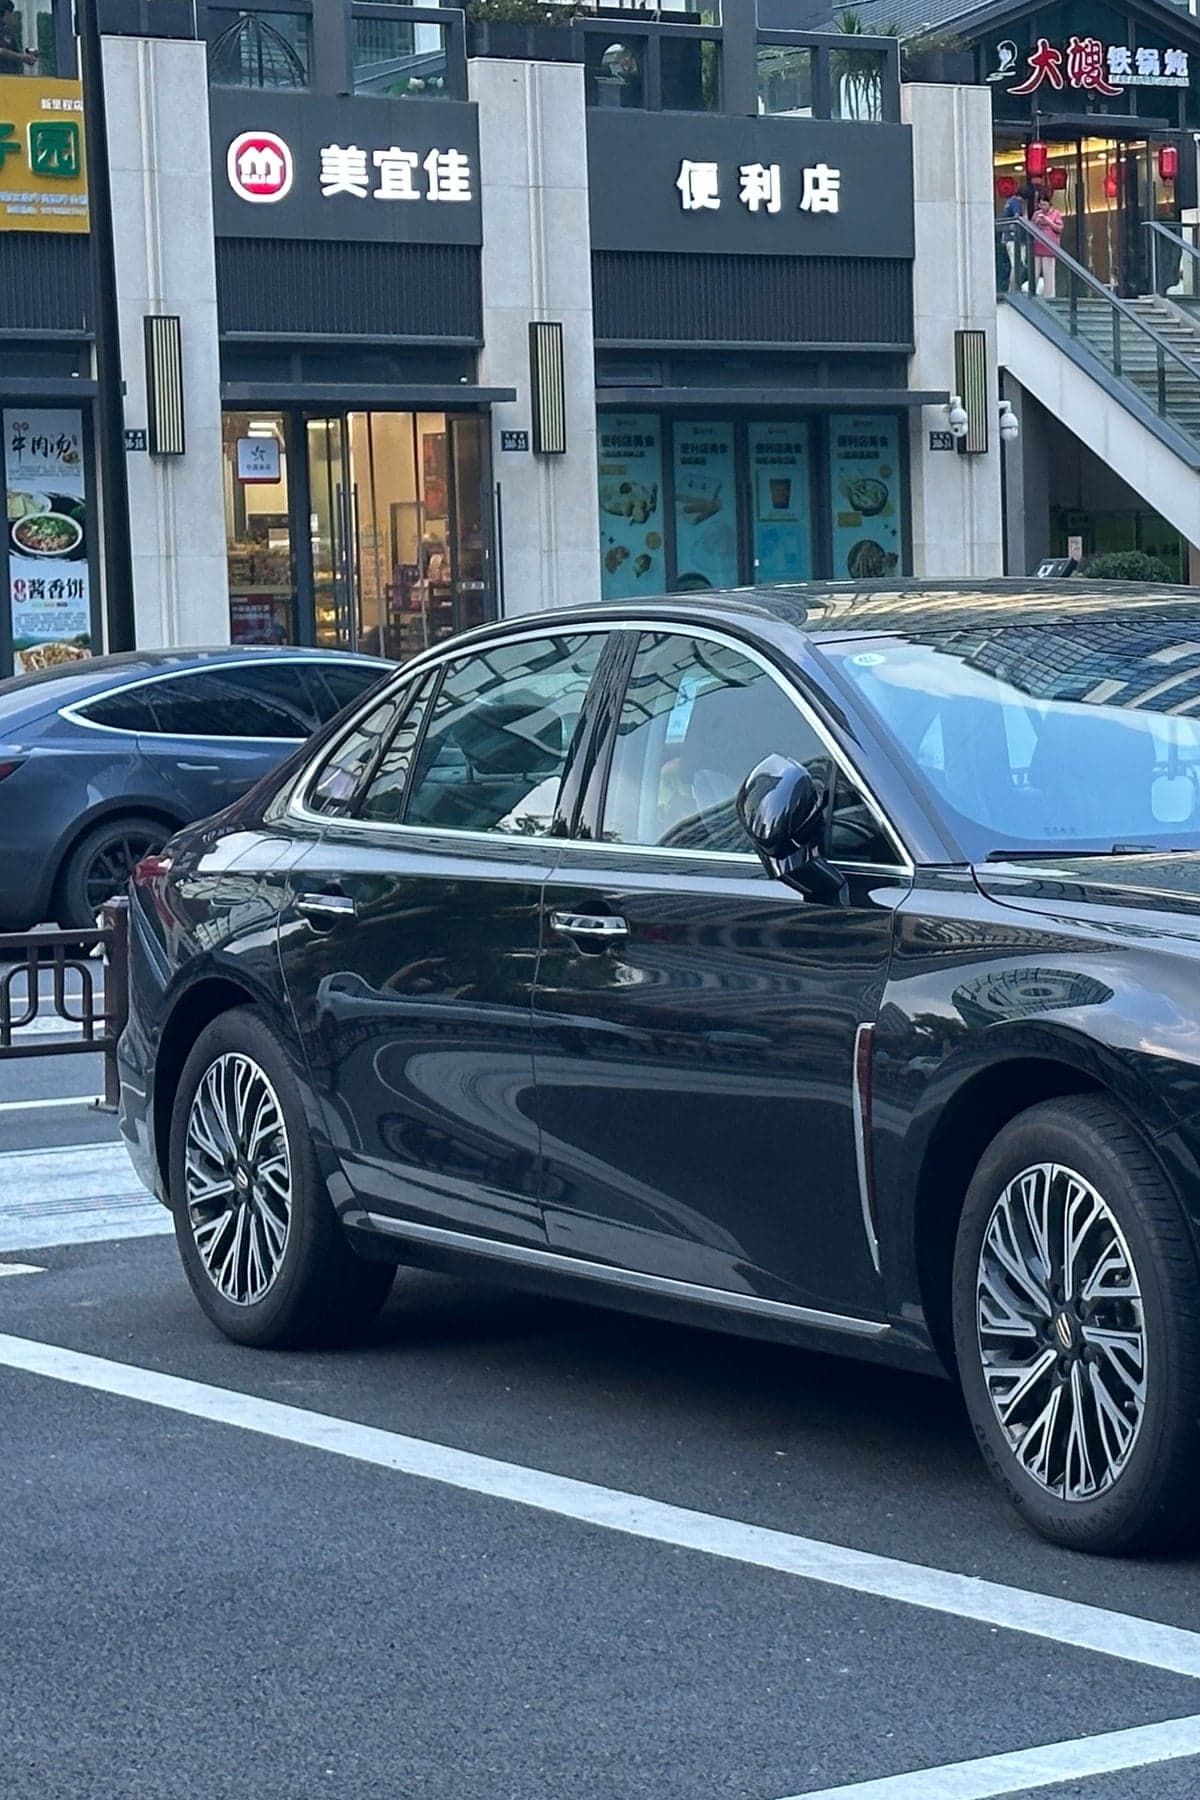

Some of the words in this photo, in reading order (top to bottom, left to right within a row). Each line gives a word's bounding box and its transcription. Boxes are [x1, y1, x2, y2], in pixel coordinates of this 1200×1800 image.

[319, 144, 472, 201] 美宜佳
[676, 159, 840, 213] 便利店
